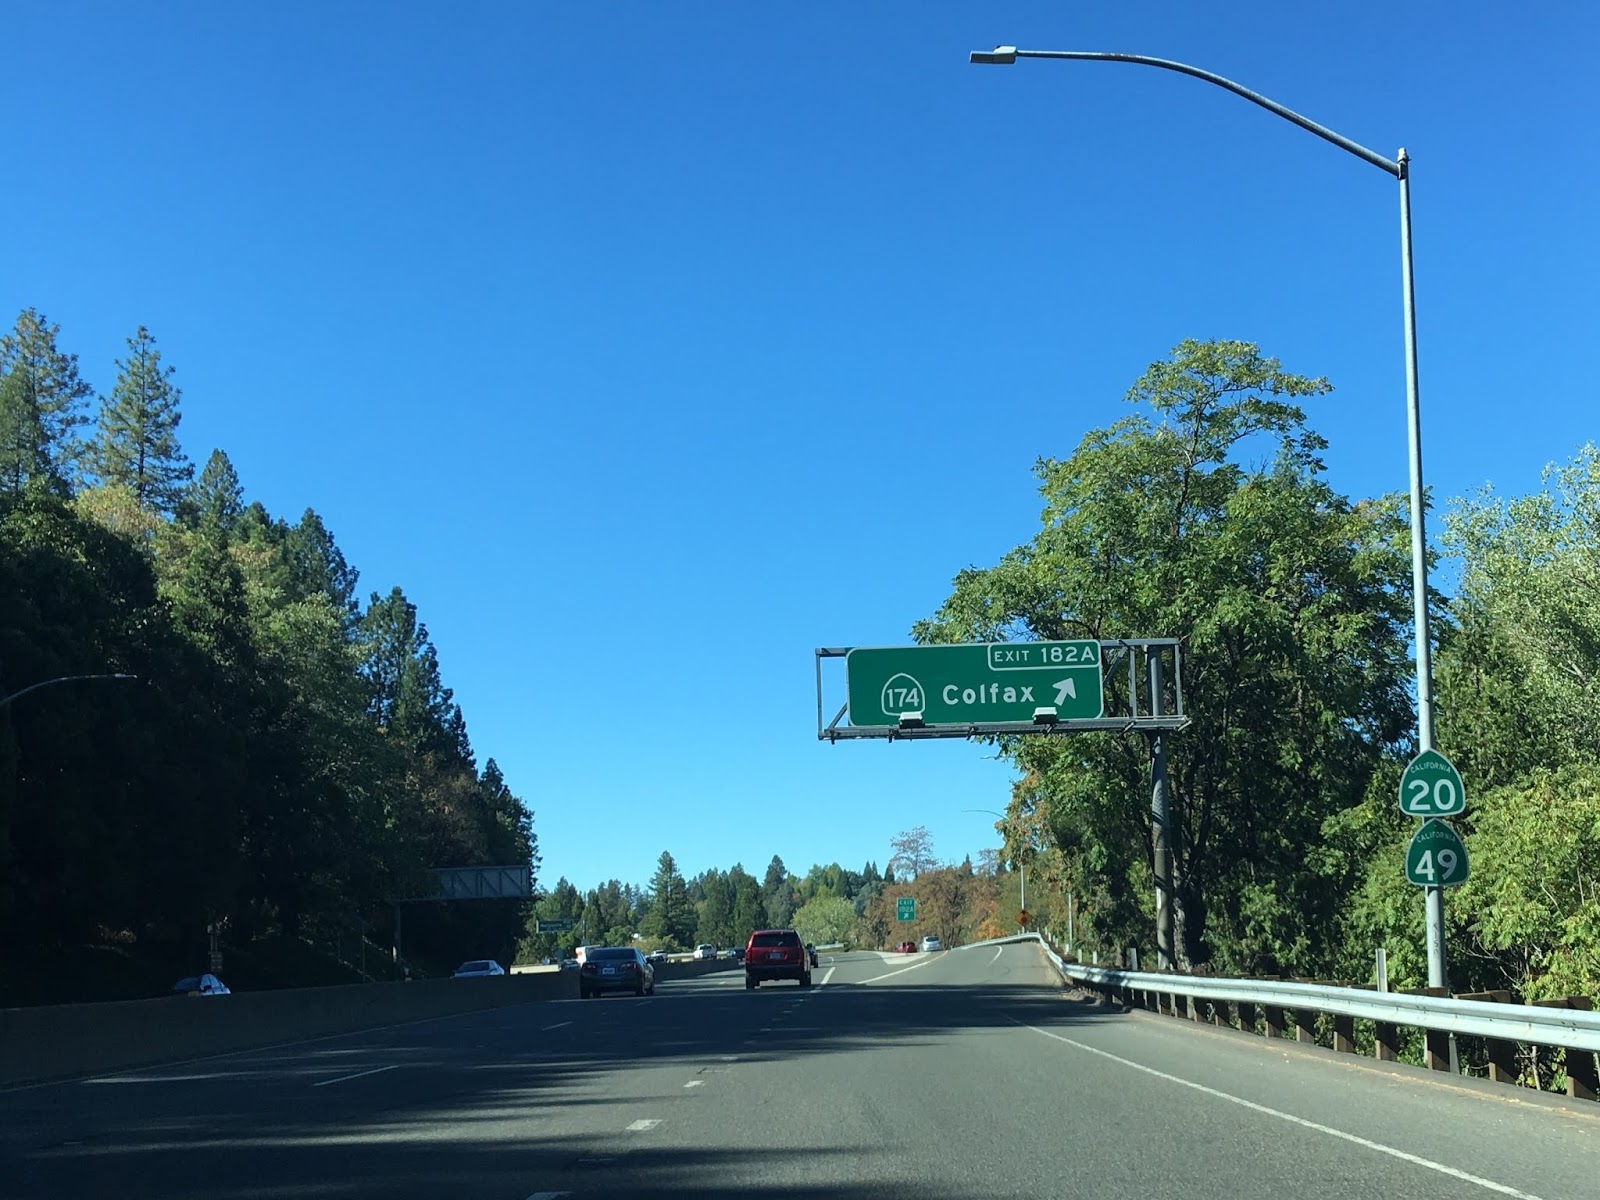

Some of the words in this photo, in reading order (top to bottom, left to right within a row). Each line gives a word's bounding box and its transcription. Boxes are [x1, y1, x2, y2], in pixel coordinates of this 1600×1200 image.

[994, 650, 1030, 662] EXIT
[1041, 646, 1095, 663] 182A
[887, 688, 920, 708] 174
[942, 683, 1035, 705] Colfax
[1410, 761, 1451, 774] CALIFORNIA
[1408, 779, 1456, 811] 20
[1416, 830, 1456, 843] CALIFORNIA
[1415, 848, 1458, 881] 49
